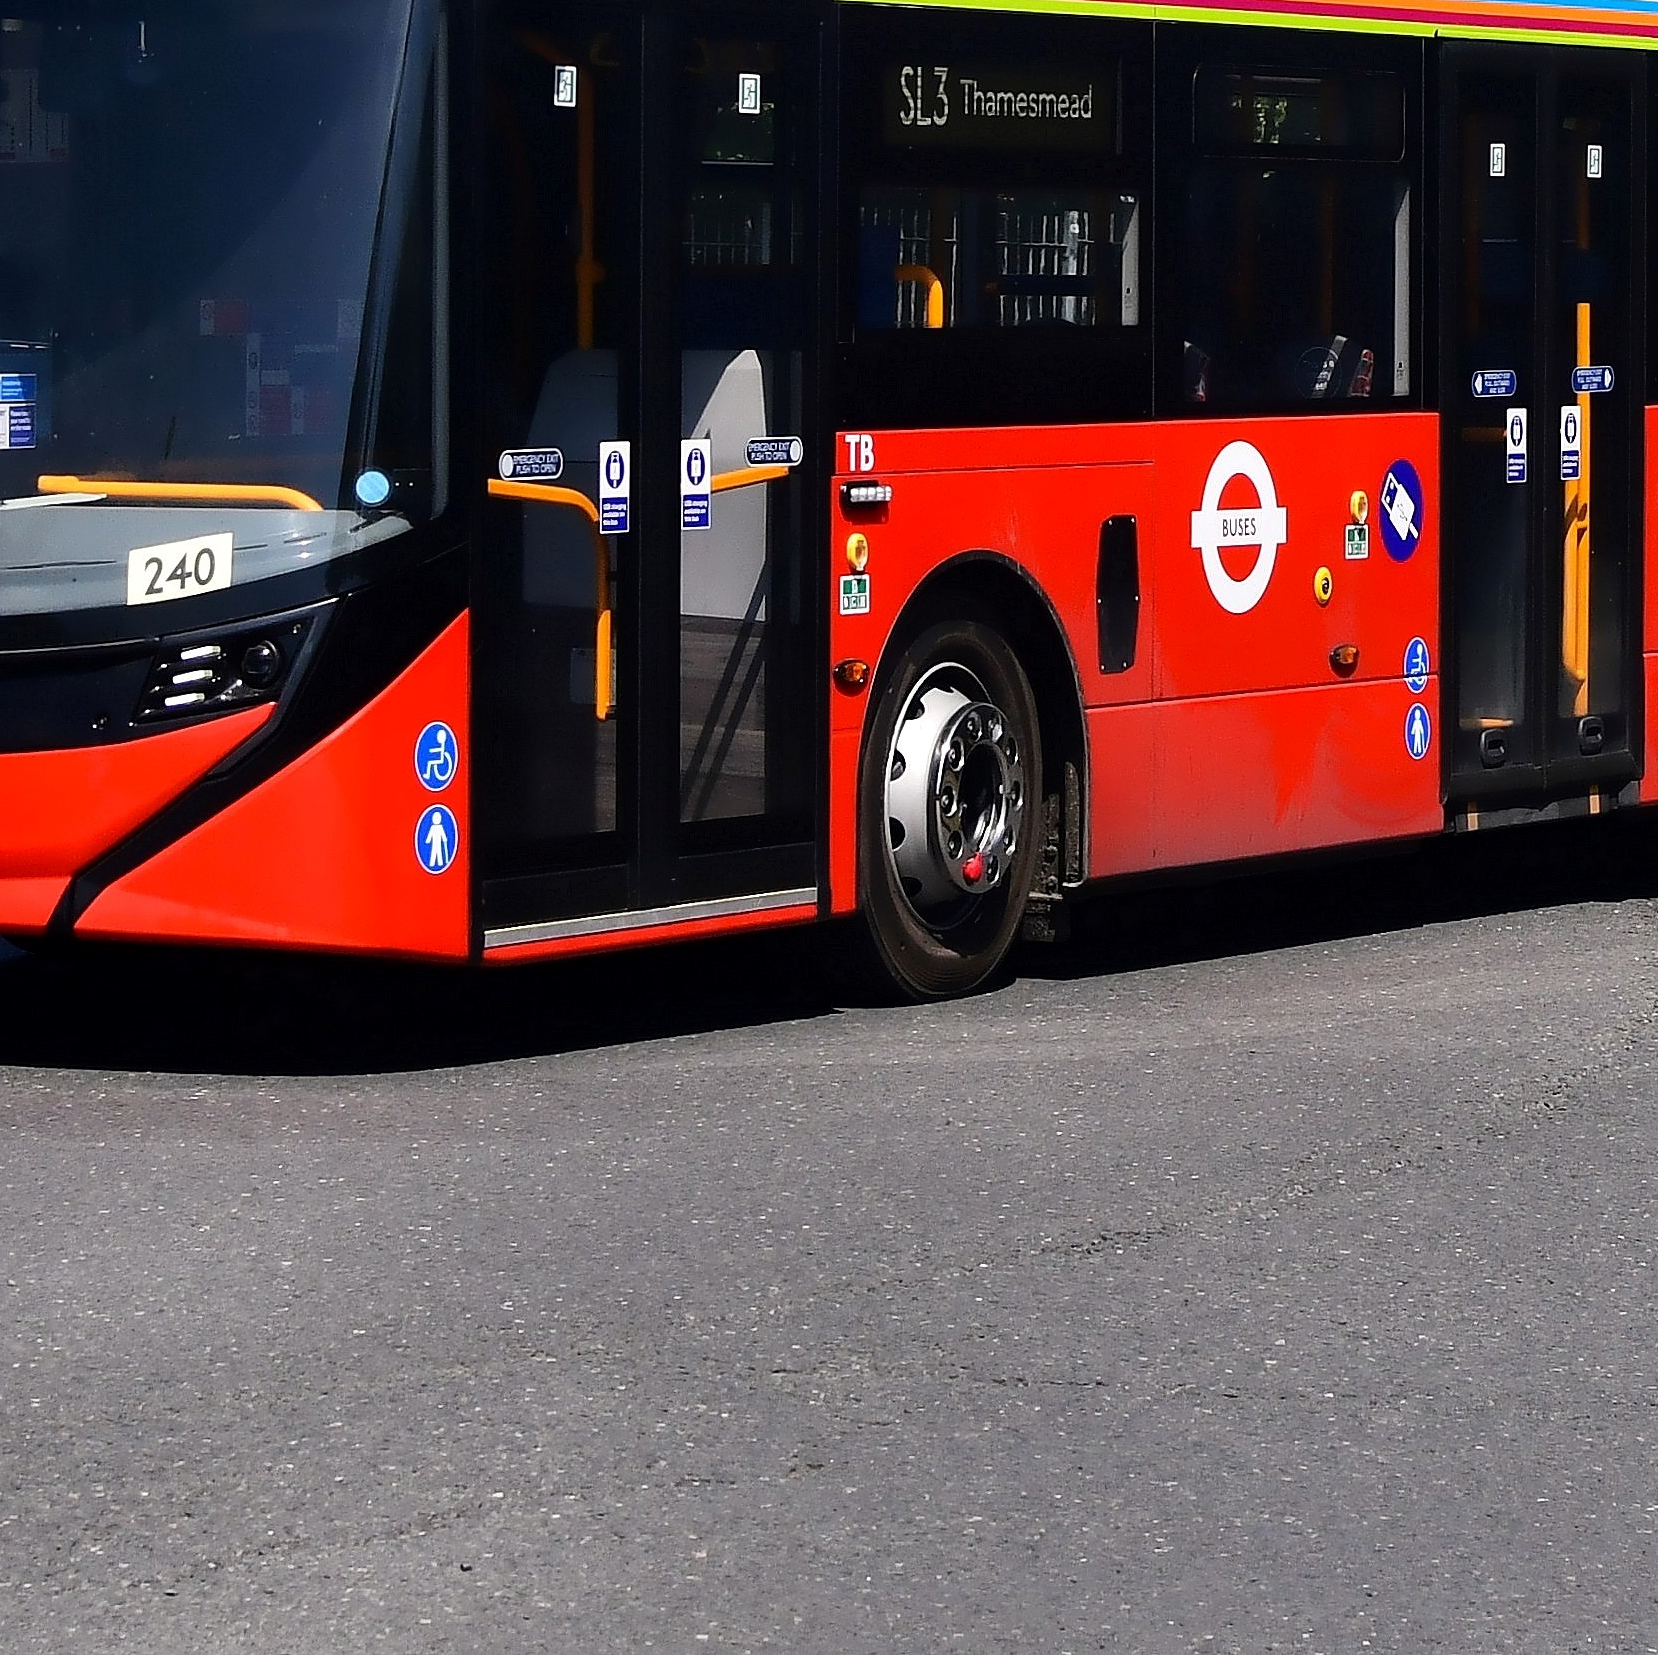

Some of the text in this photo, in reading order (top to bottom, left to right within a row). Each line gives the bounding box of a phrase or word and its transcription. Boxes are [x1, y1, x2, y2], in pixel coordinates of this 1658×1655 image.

[900, 66, 1093, 126] SL3 Thamesmead
[845, 434, 874, 472] TB
[1222, 517, 1256, 537] BUSES
[144, 547, 216, 596] 240
